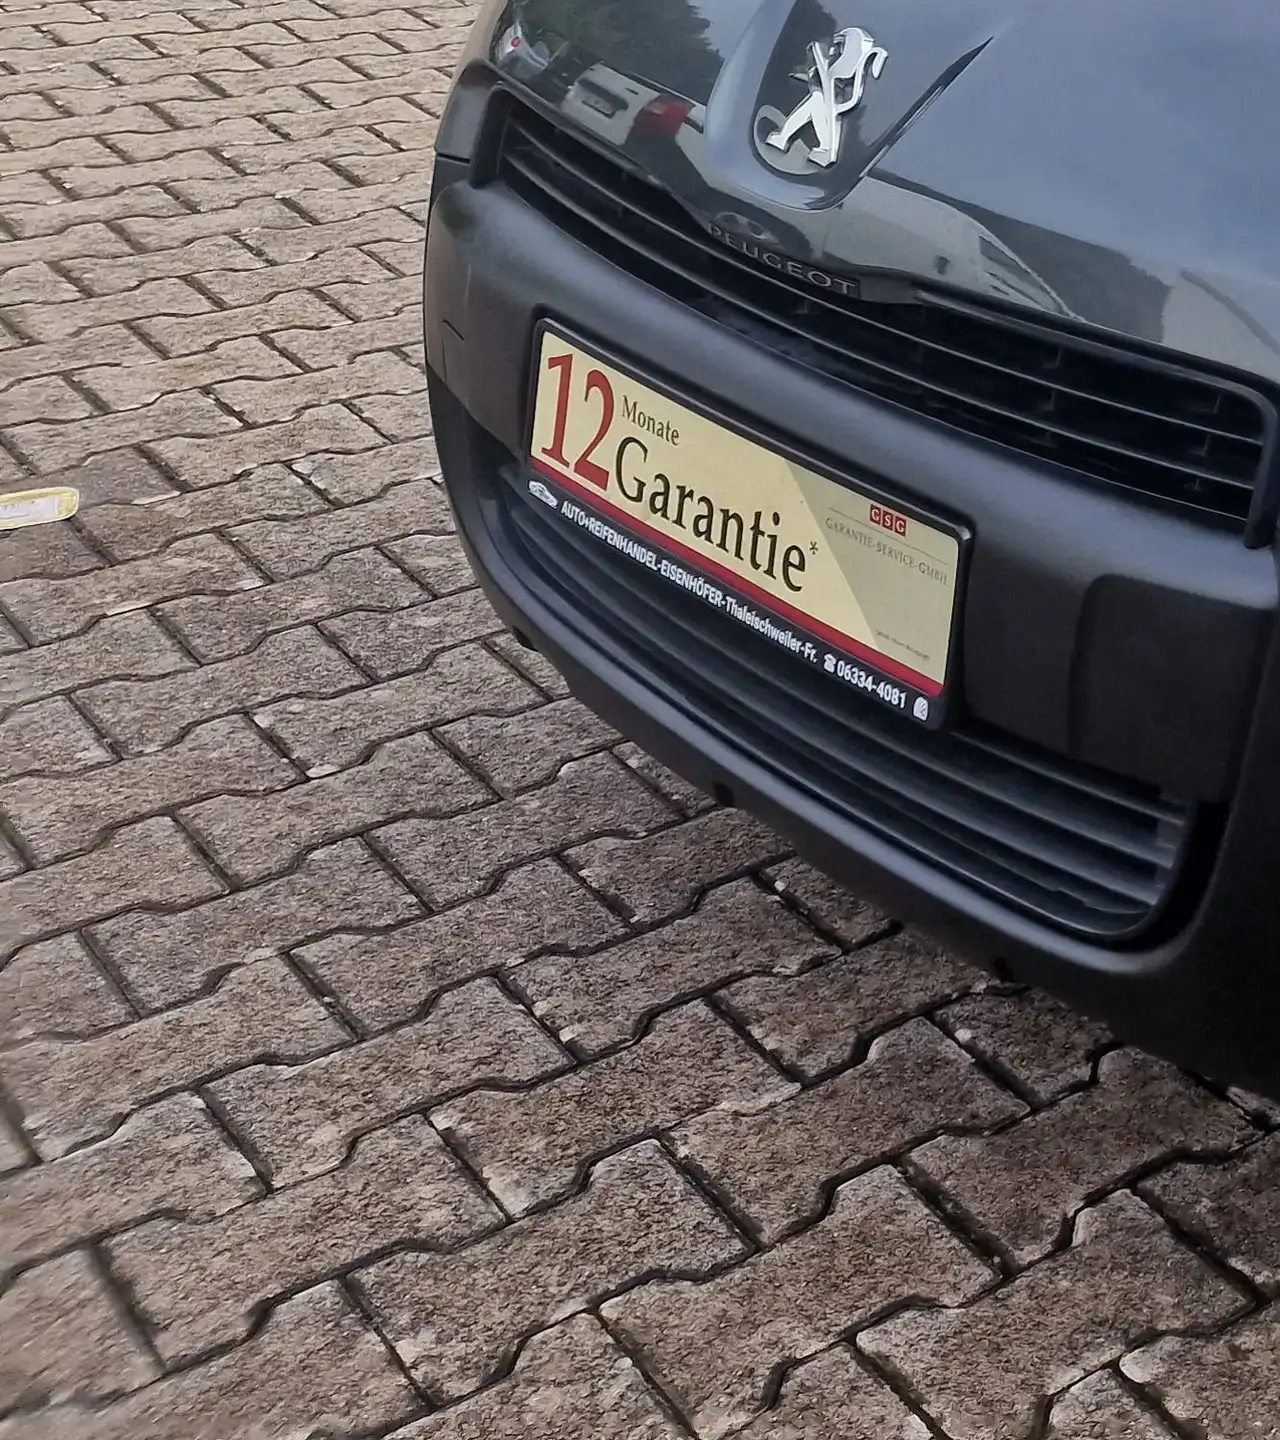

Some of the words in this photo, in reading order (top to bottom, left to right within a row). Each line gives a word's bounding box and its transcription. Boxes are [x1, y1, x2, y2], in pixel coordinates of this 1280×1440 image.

[707, 223, 856, 295] PEUGEOT
[541, 353, 615, 492] 12
[621, 394, 681, 447] Monate
[869, 504, 907, 537] GSG
[836, 660, 908, 710] 06334-4081
